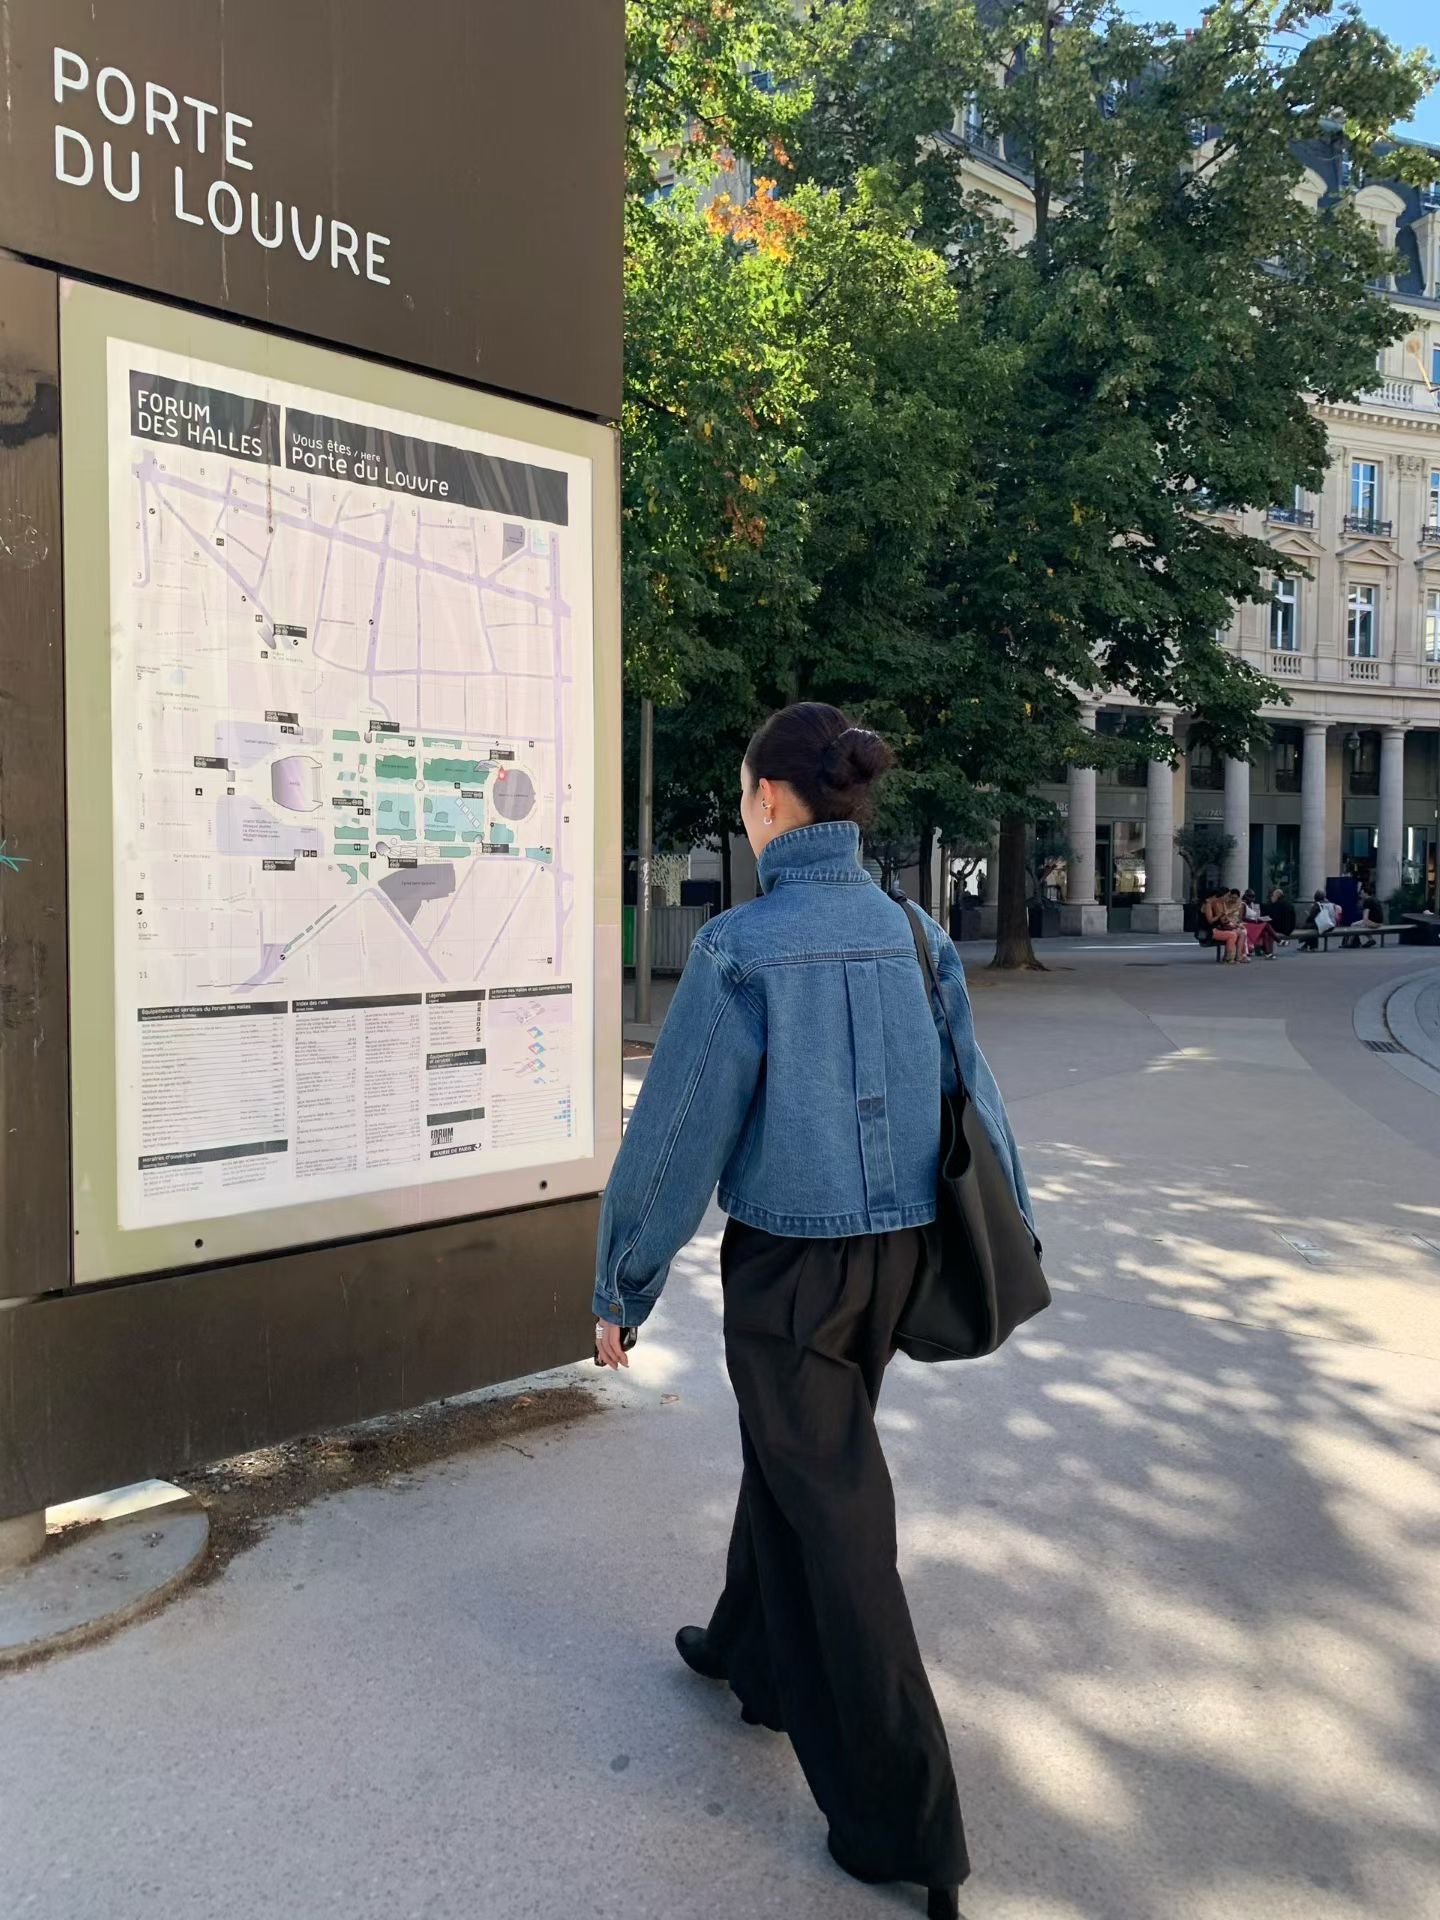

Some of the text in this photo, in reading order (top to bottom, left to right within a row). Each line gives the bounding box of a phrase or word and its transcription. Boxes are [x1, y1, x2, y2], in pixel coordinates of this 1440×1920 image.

[54, 46, 254, 171] PORTE
[55, 124, 391, 286] DU LOUVRE
[137, 389, 210, 424] FORUM
[138, 411, 263, 457] DES HALLES
[292, 432, 323, 451] Vous
[326, 439, 352, 457] êtes
[360, 451, 381, 463] Here
[292, 446, 450, 497] Porte du Louvre
[138, 921, 148, 930] 10
[139, 971, 148, 979] 11
[431, 1128, 453, 1139] FORUM
